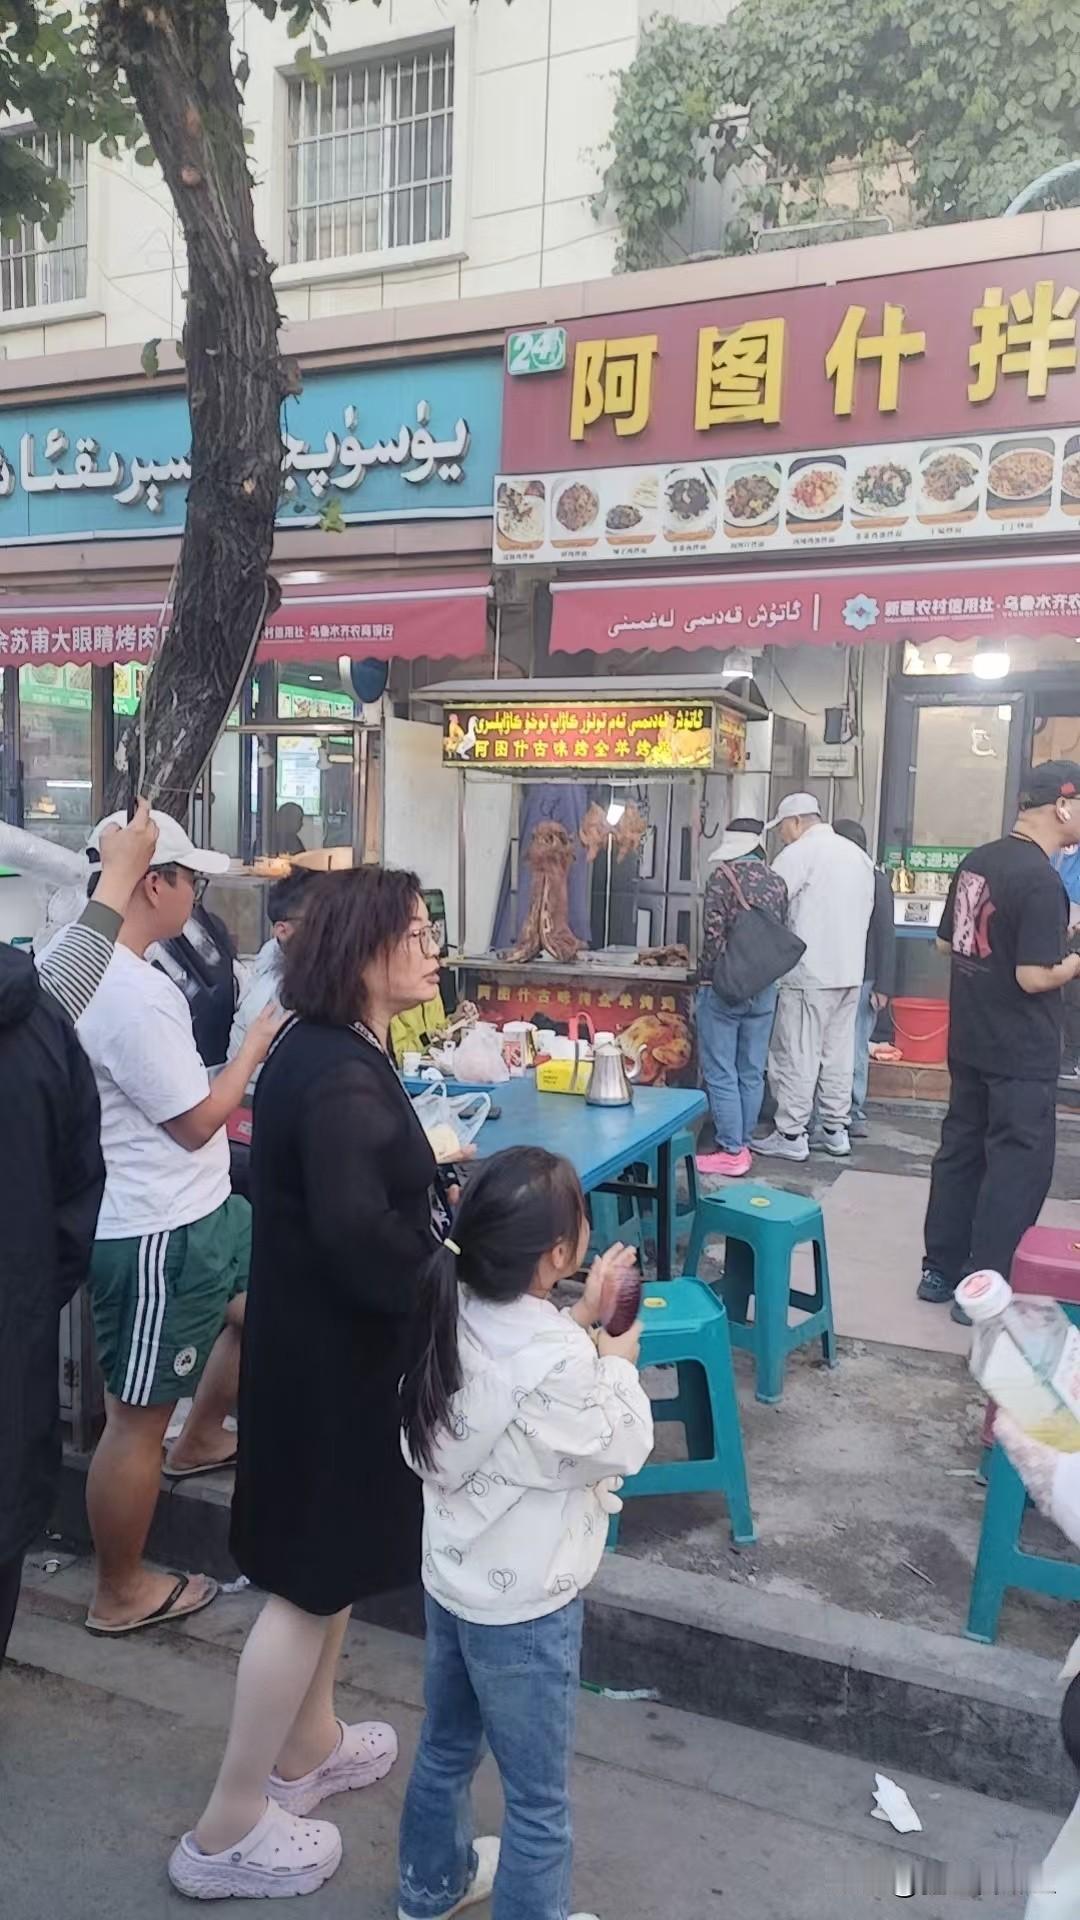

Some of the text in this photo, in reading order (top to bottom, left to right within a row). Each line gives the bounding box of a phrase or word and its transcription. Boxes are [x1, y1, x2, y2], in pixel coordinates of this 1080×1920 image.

[570, 279, 1080, 442] 阿图什拌
[281, 399, 470, 498] يۈسۈپج
